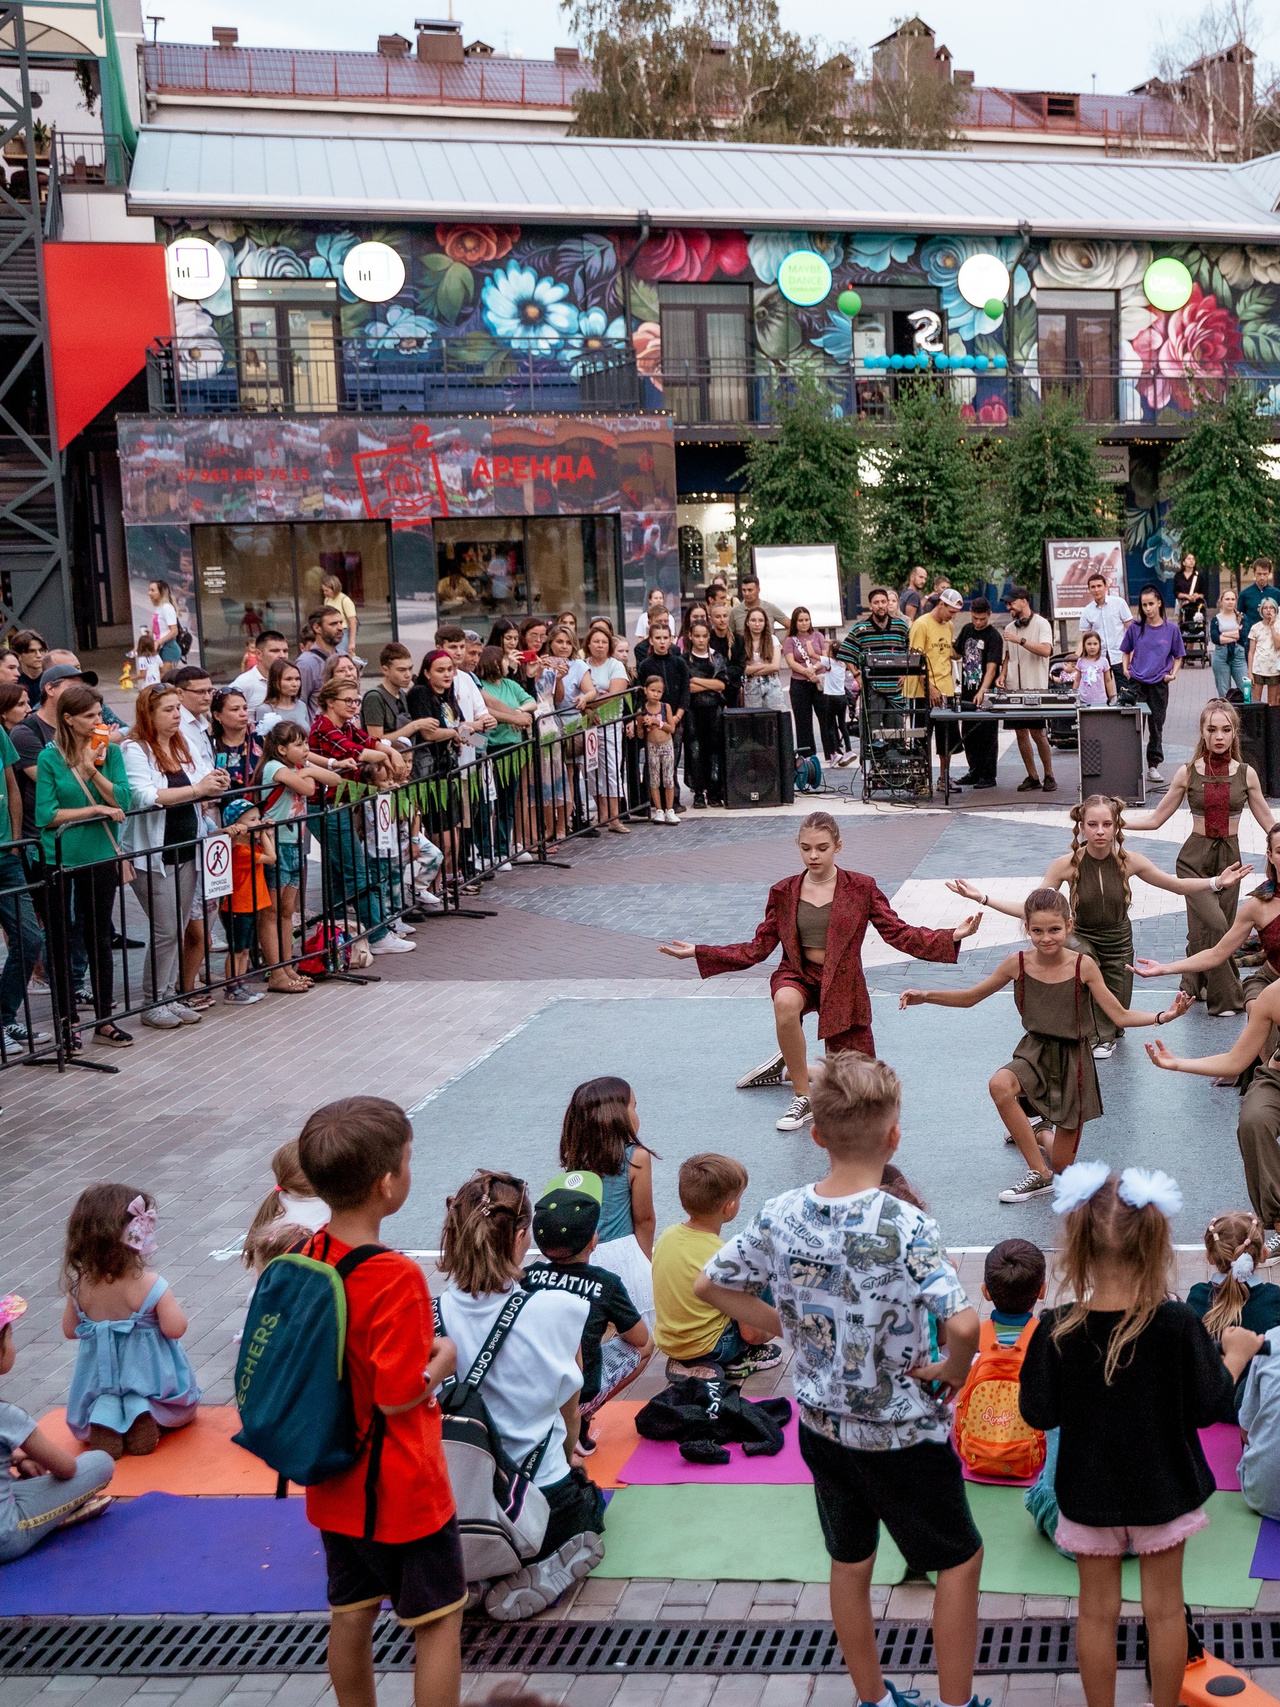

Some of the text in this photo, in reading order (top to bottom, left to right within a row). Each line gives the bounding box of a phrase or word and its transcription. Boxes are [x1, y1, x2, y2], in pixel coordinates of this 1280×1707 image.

[234, 468, 265, 482] 669
[472, 455, 597, 483] АРЕНДА
[1057, 547, 1088, 559] SENS
[211, 878, 227, 886] ПРОХОД
[488, 1329, 503, 1350] SPORT
